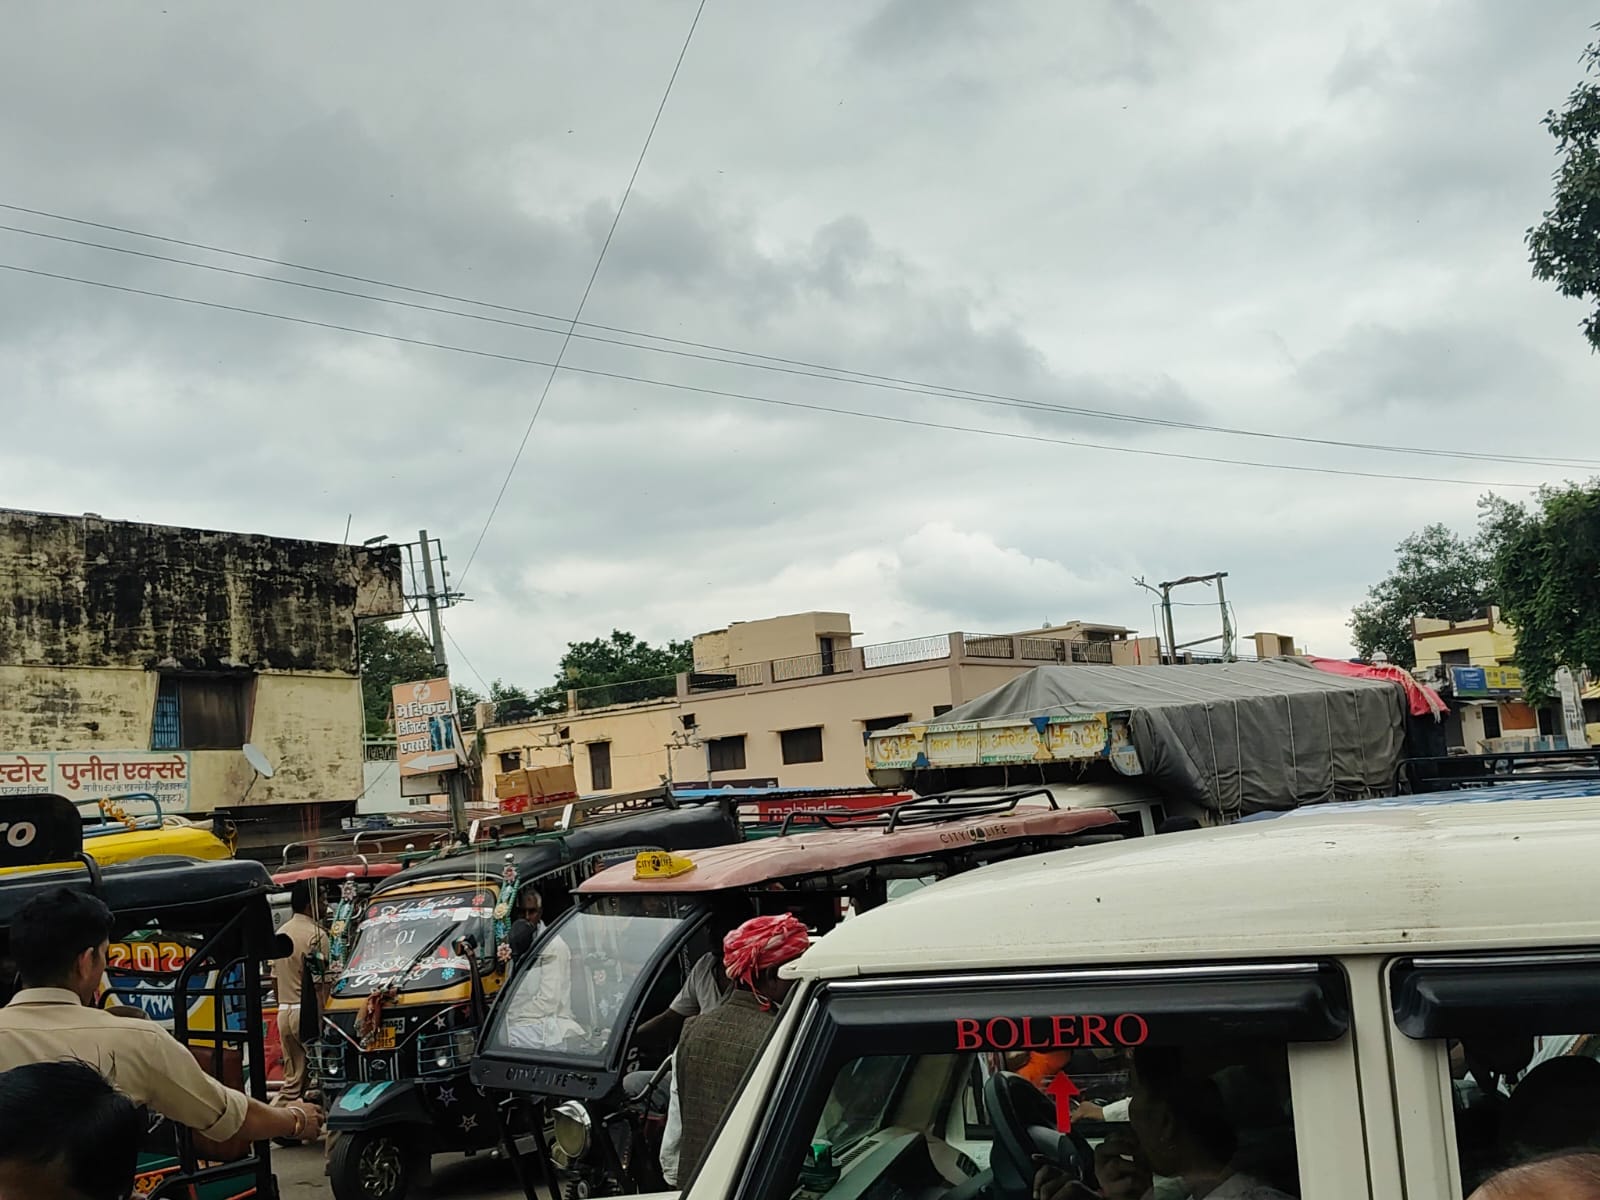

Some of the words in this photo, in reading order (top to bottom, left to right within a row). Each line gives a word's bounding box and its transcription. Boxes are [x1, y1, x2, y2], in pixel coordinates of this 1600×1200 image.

[58, 755, 119, 790] पुनीत
[122, 755, 187, 781] एक्सरे
[940, 831, 966, 843] CITY
[984, 824, 1008, 837] LIFE
[955, 1013, 1149, 1050] BOLERO
